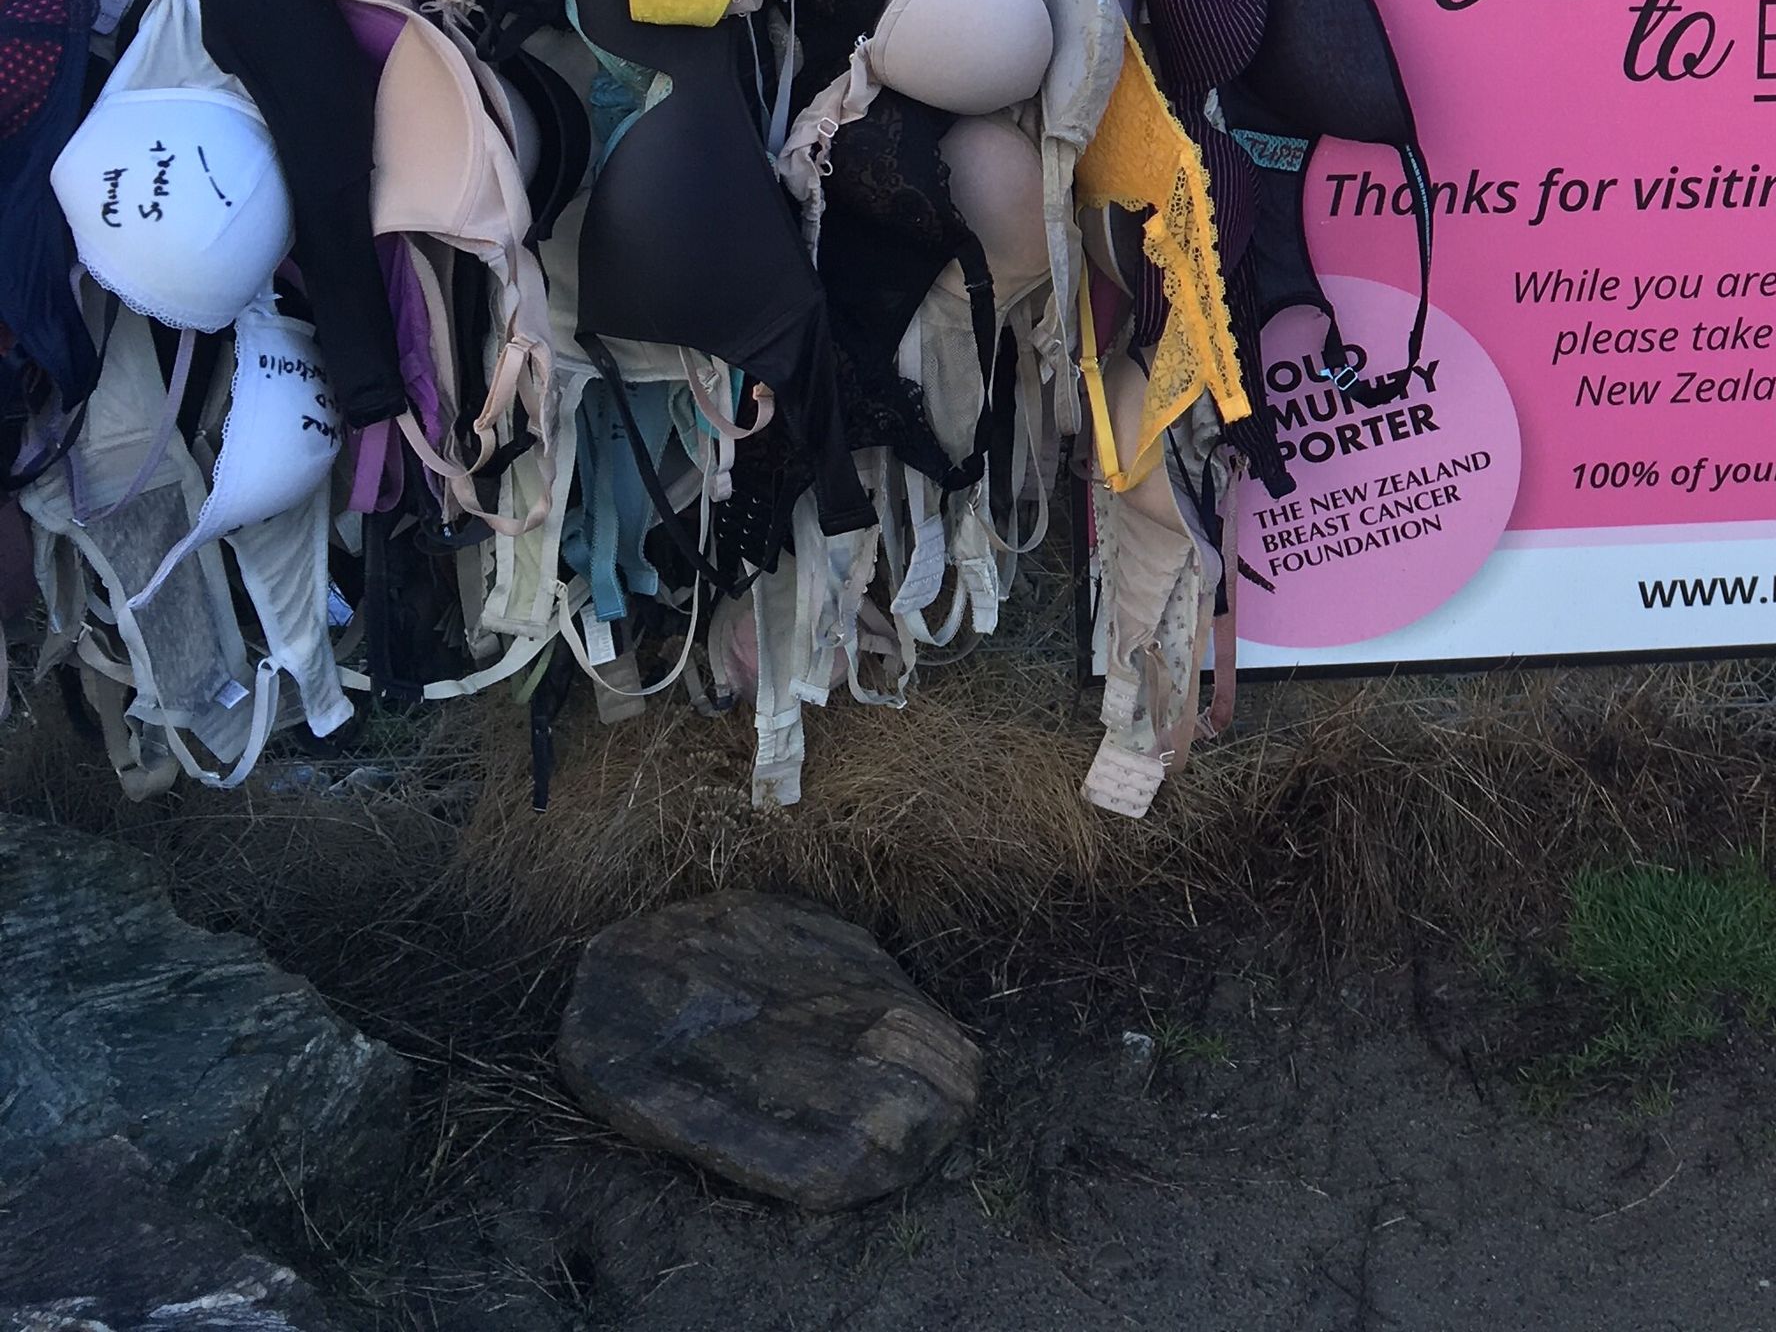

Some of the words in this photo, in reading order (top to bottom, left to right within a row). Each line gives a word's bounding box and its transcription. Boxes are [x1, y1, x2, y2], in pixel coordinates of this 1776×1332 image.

[1326, 169, 1520, 216] Thanks
[1529, 168, 1617, 226] for
[1516, 269, 1619, 303] While
[1627, 275, 1703, 310] you
[1552, 322, 1678, 365] please
[1693, 317, 1773, 350] take
[1576, 376, 1661, 406] New
[1278, 403, 1441, 464] PORTER
[1253, 502, 1303, 528] THE
[1311, 483, 1368, 515] NEW
[1373, 451, 1491, 497] ZEALAND
[1574, 462, 1659, 488] 100%
[1671, 458, 1708, 492] of
[1262, 513, 1351, 553] BREAST
[1359, 484, 1461, 525] CANCER
[1268, 514, 1442, 576] FOUNDATION
